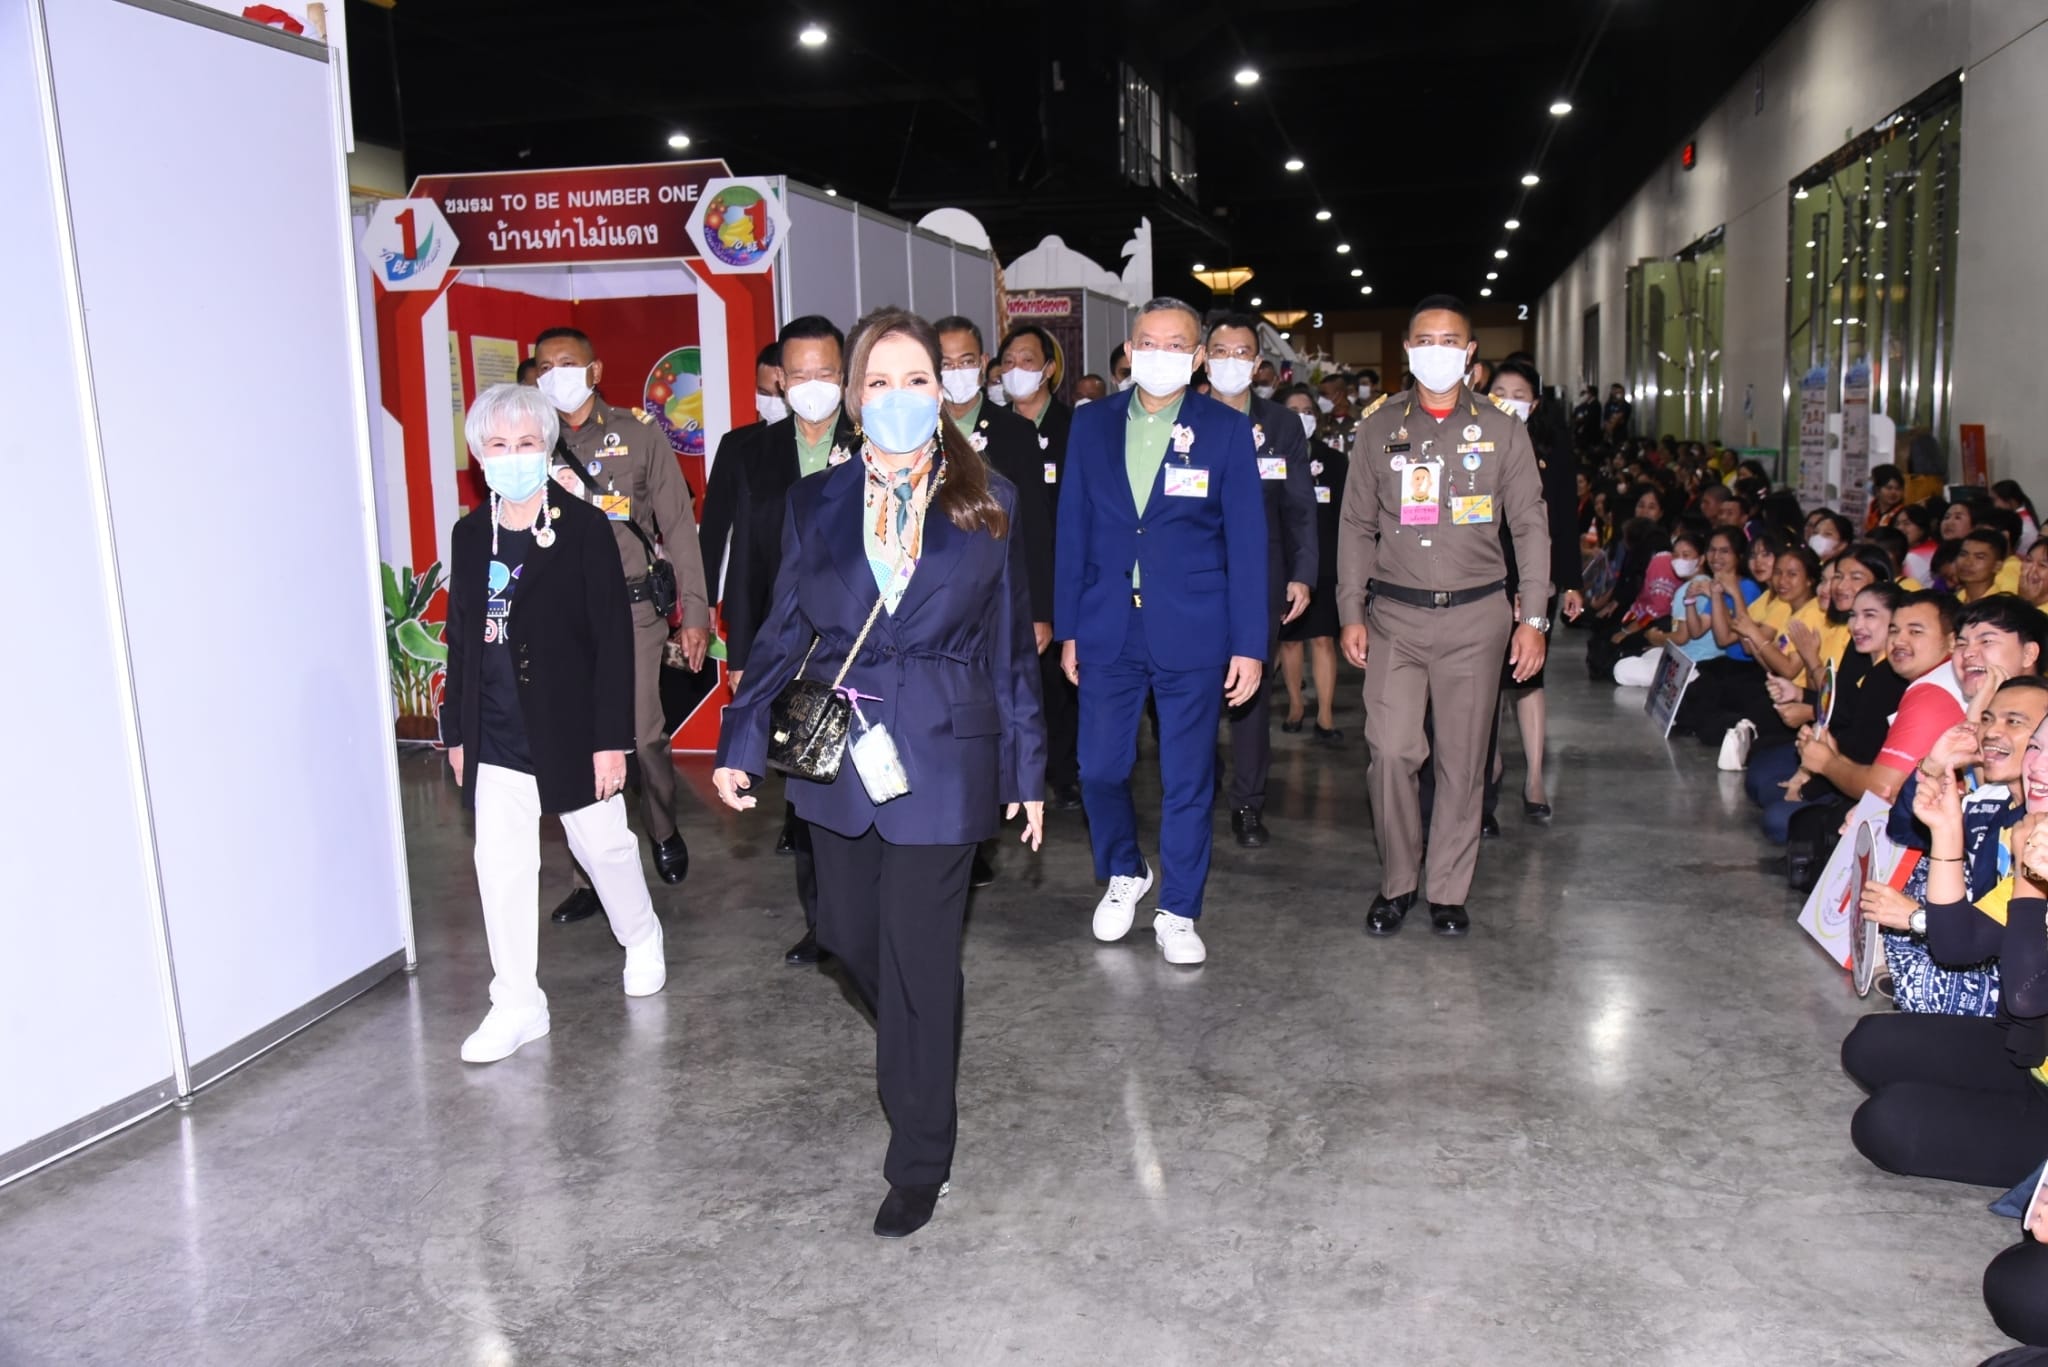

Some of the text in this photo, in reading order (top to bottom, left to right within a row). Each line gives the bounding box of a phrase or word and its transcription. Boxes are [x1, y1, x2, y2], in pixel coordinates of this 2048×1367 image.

[445, 196, 493, 214] ชมรม
[501, 184, 698, 211] TO BE NUMBER ONE
[394, 207, 418, 260] 1
[489, 216, 659, 252] บ้านท่าไม้แดง
[743, 199, 768, 251] 1
[392, 260, 411, 275] BE
[1312, 313, 1323, 328] 3
[1518, 304, 1529, 321] 2
